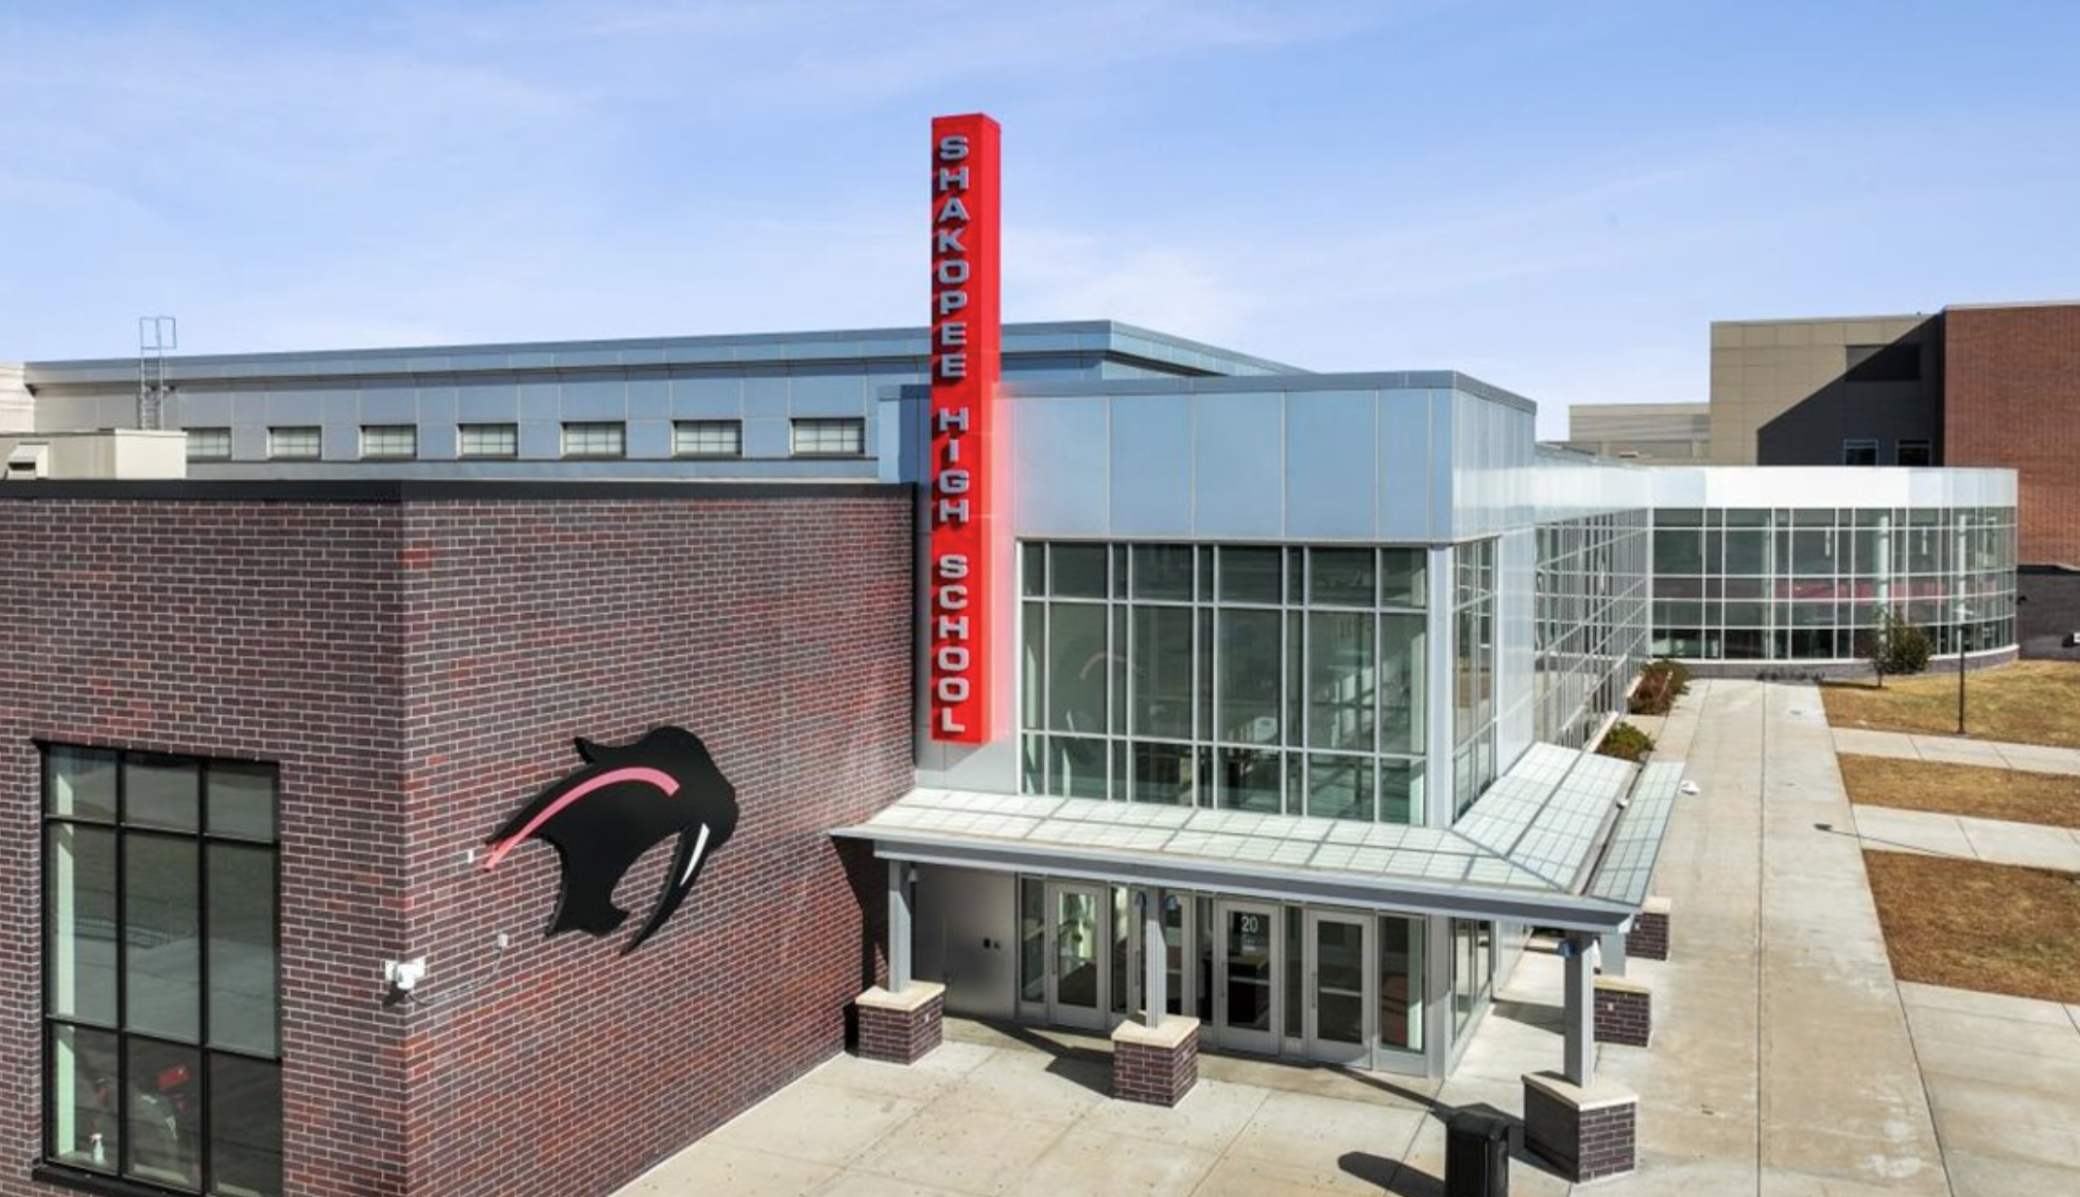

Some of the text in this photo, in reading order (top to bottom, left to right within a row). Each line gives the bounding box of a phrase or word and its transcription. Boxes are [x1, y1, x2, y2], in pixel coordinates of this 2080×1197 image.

[937, 135, 970, 732] SHAKOPEE HIGH SCHOOL
[1241, 915, 1258, 933] 20
